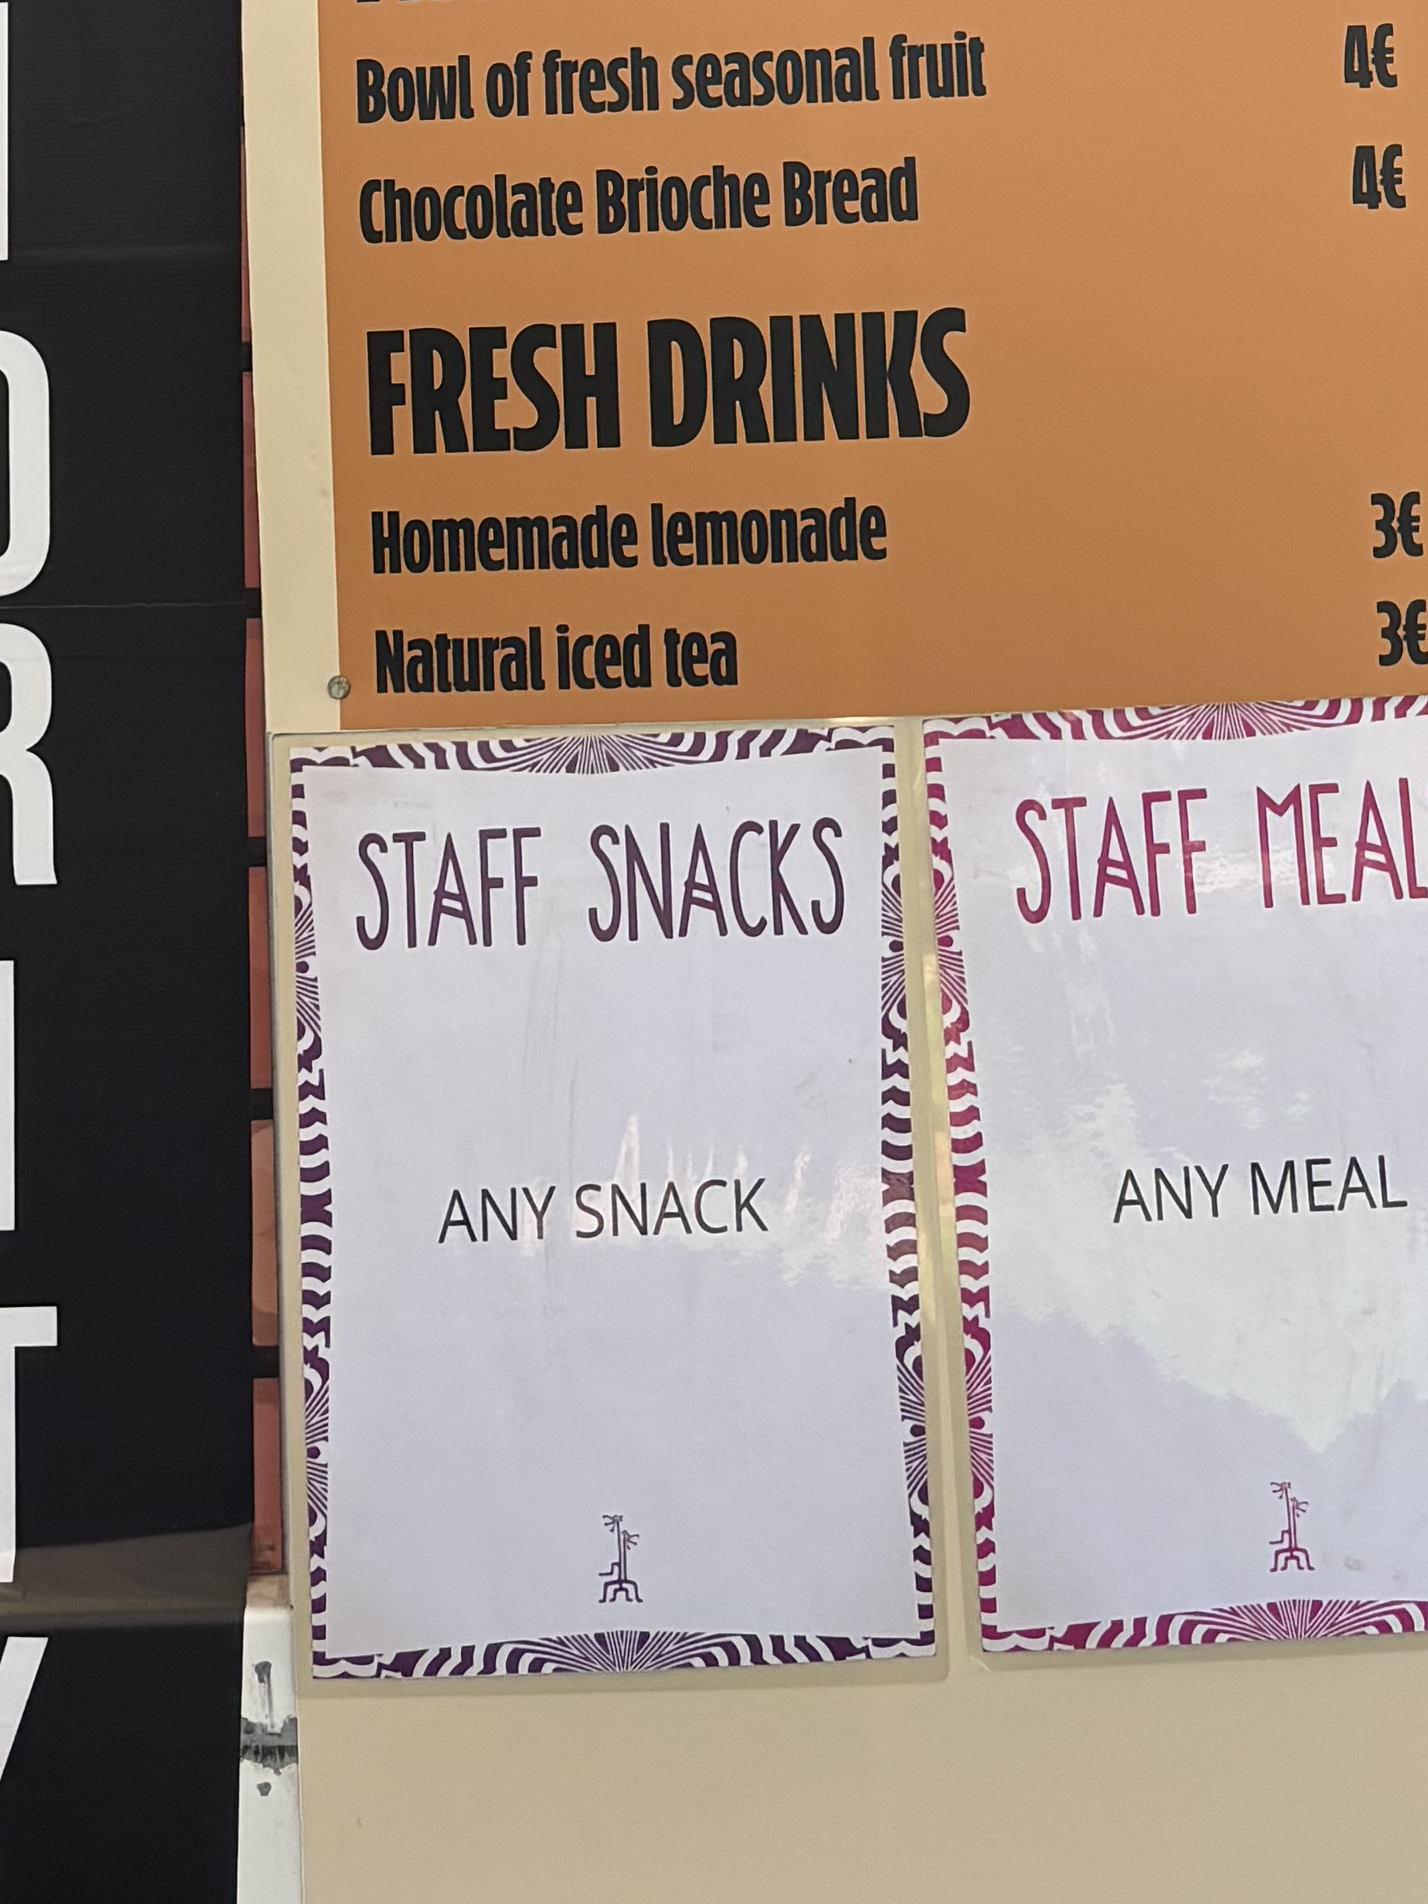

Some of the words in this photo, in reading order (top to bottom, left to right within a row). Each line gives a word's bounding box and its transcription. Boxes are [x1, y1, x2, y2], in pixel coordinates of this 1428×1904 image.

[356, 54, 475, 124] Bowl
[485, 50, 533, 118] of
[542, 46, 660, 116] fresh
[671, 36, 880, 111] seasonal
[888, 30, 987, 100] fruit
[1343, 22, 1399, 89] 4€
[359, 173, 584, 245] Chocolate
[595, 164, 771, 235] Brioche
[782, 156, 919, 227] Bread
[1352, 143, 1407, 210] 4€
[366, 321, 622, 456] FRESH
[646, 307, 971, 448] DRINKS
[370, 504, 639, 575] Homemade
[650, 496, 888, 568] lemonade
[1370, 490, 1424, 559] 3€
[374, 626, 546, 694] Natural
[555, 623, 653, 690] iced
[663, 627, 739, 688] tea
[355, 826, 542, 951] STAFF
[588, 816, 845, 943] SNACKS
[1015, 787, 1208, 925] STAFF
[437, 1185, 557, 1244] ANY
[575, 1177, 769, 1239] SNACK
[1113, 1163, 1229, 1224] ANY
[1250, 1154, 1408, 1216] MEAL
